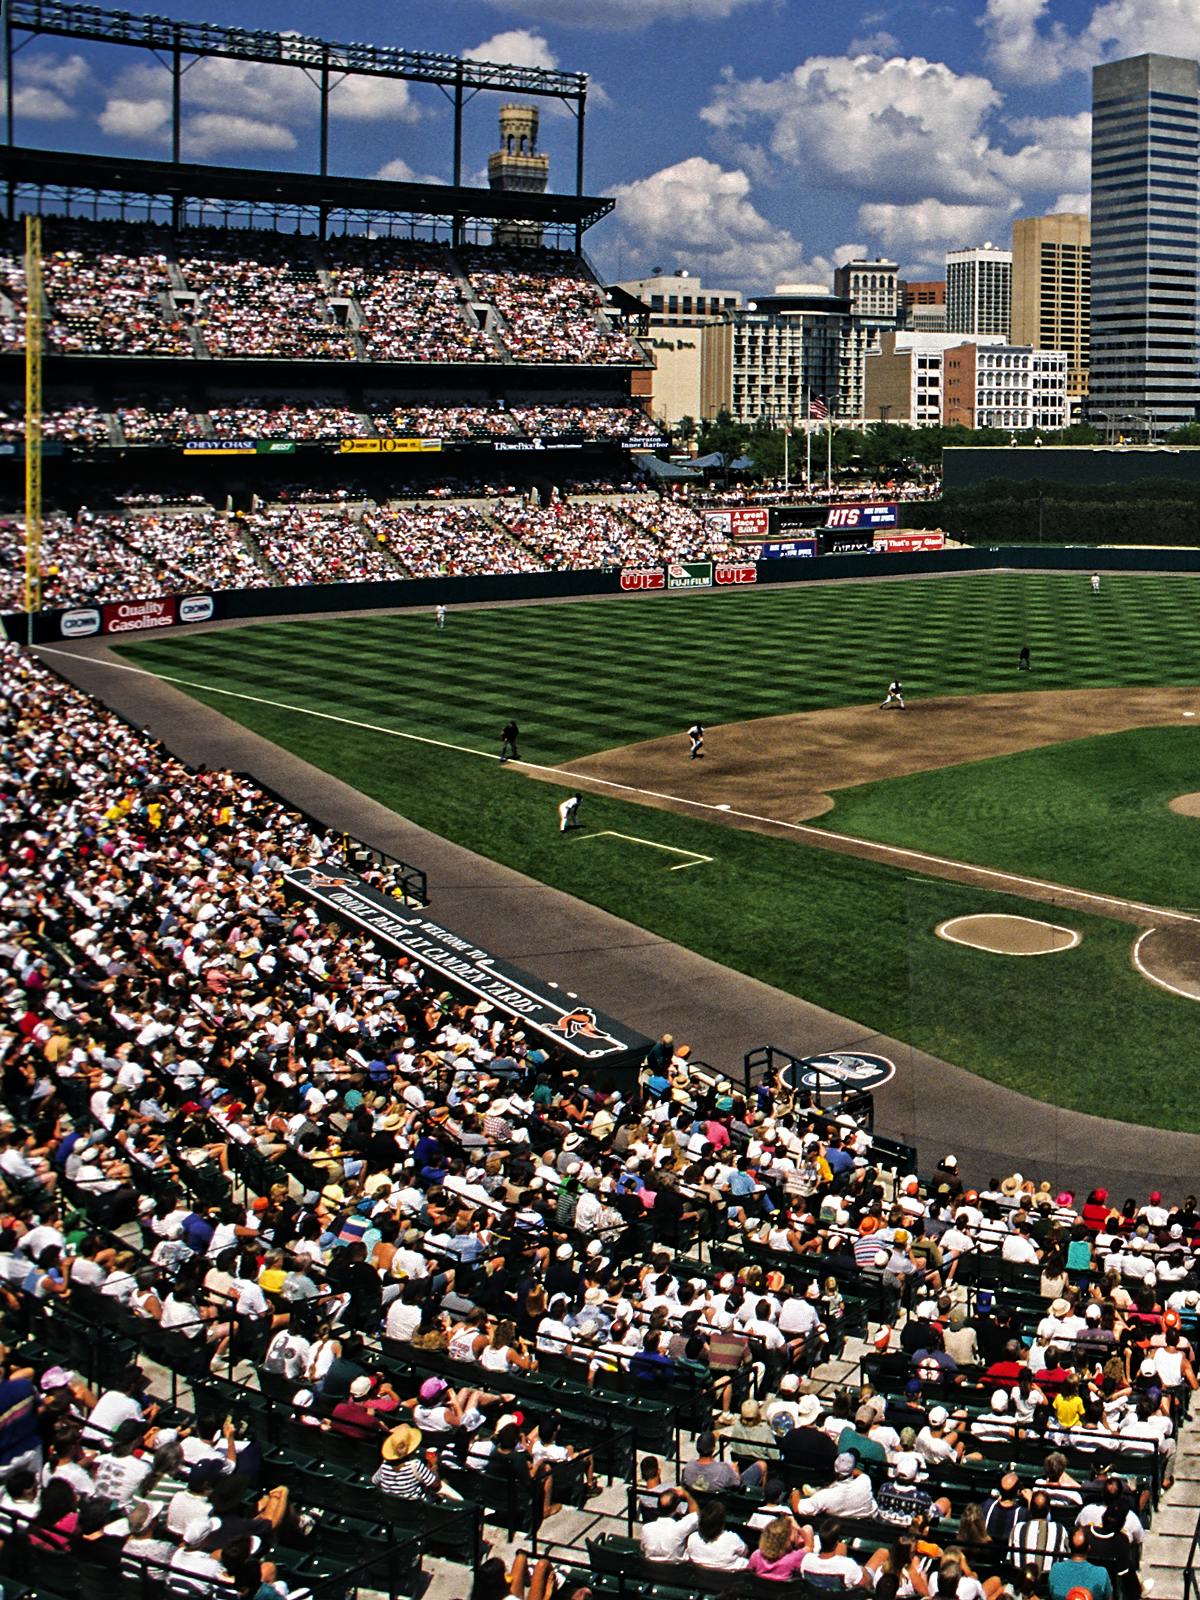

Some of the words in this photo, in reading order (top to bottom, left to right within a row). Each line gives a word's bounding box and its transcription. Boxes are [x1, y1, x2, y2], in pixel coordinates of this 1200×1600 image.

[743, 511, 764, 520] great
[827, 509, 860, 526] HTS
[621, 574, 665, 590] WIZ
[715, 568, 757, 584] WIZ
[118, 601, 165, 618] Quality
[108, 615, 173, 632] Gasolines
[420, 922, 473, 951] WELCOME
[466, 949, 488, 959] TO
[328, 892, 379, 916] ORIOLE
[368, 916, 413, 938] PARK
[402, 937, 432, 948] AT
[422, 948, 492, 982] CAMDEN
[481, 981, 543, 1012] YARDS
